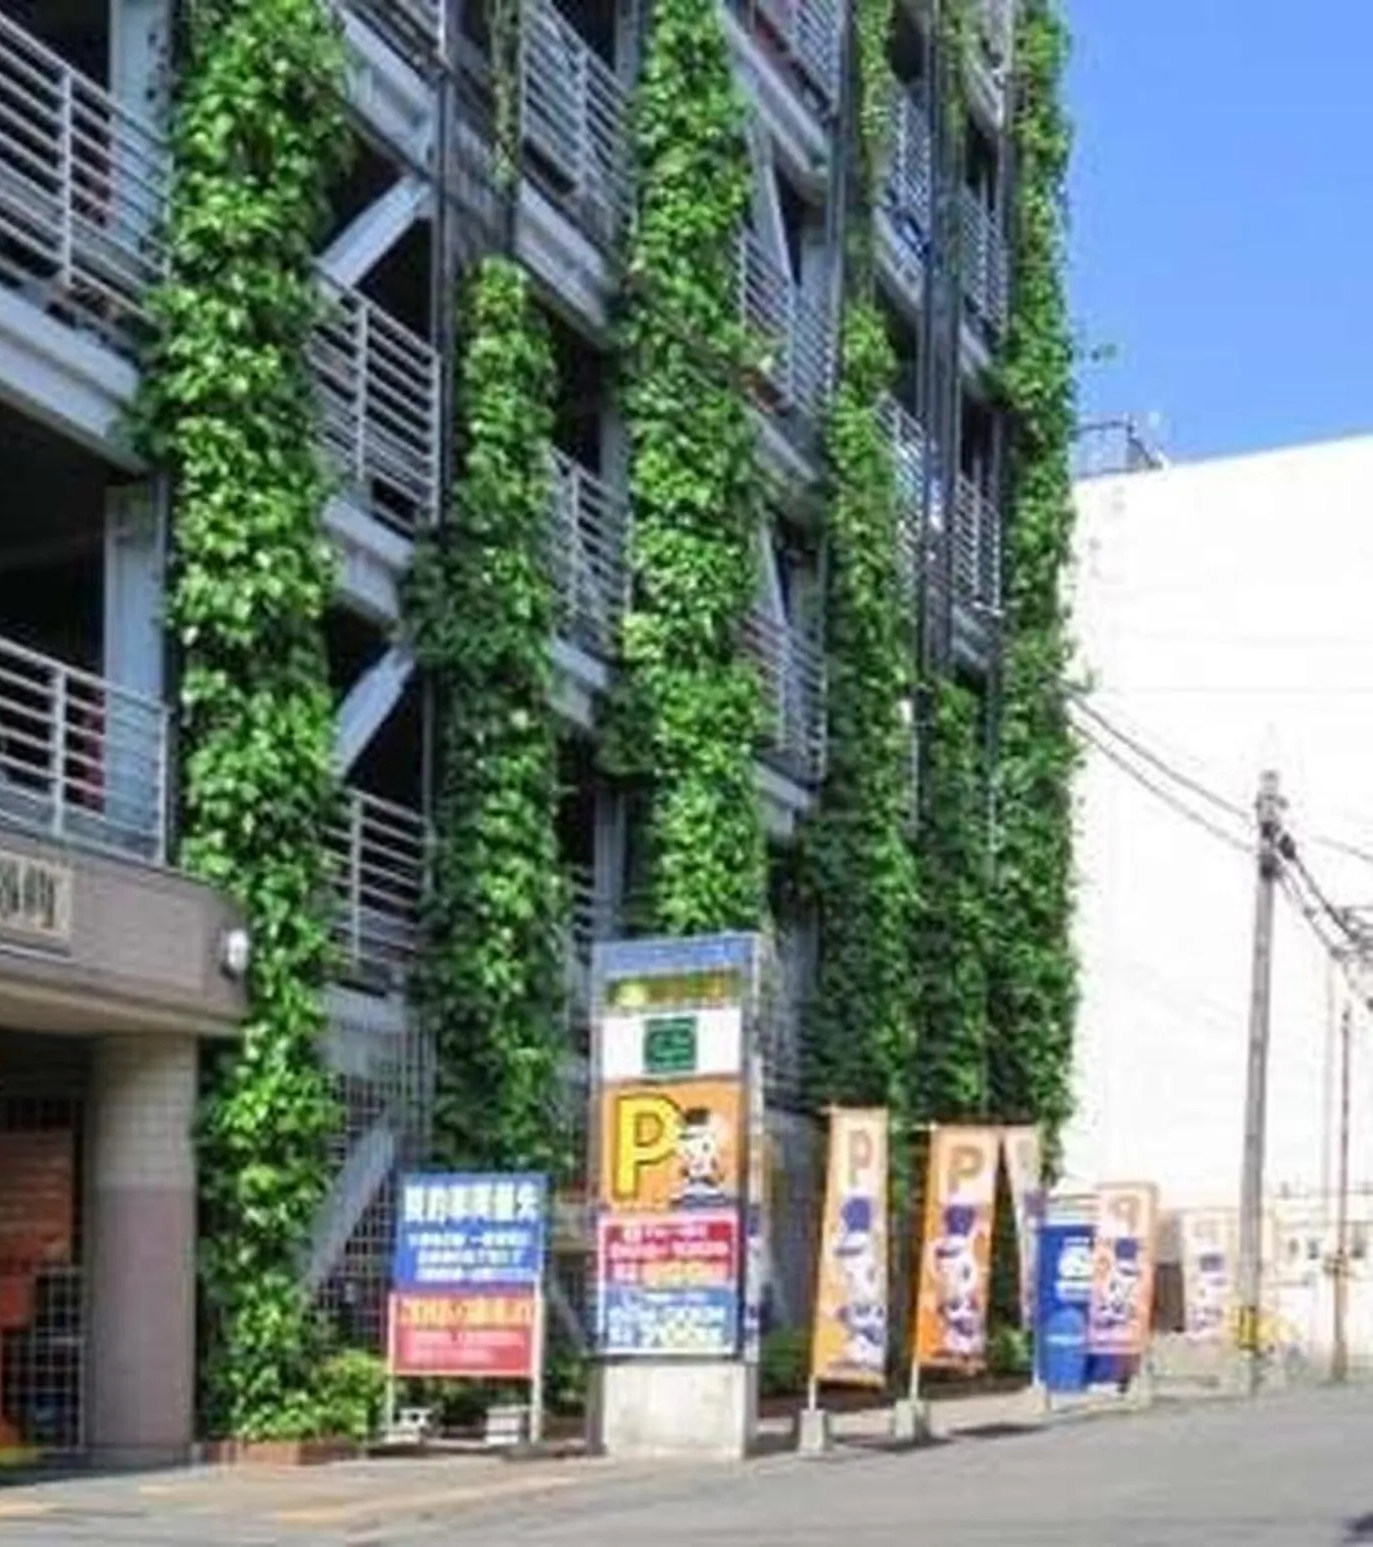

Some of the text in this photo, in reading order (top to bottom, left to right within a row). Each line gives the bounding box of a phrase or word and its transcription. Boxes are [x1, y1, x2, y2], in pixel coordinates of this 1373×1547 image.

[611, 1092, 686, 1201] P
[848, 1128, 874, 1187] P
[947, 1144, 985, 1195] P
